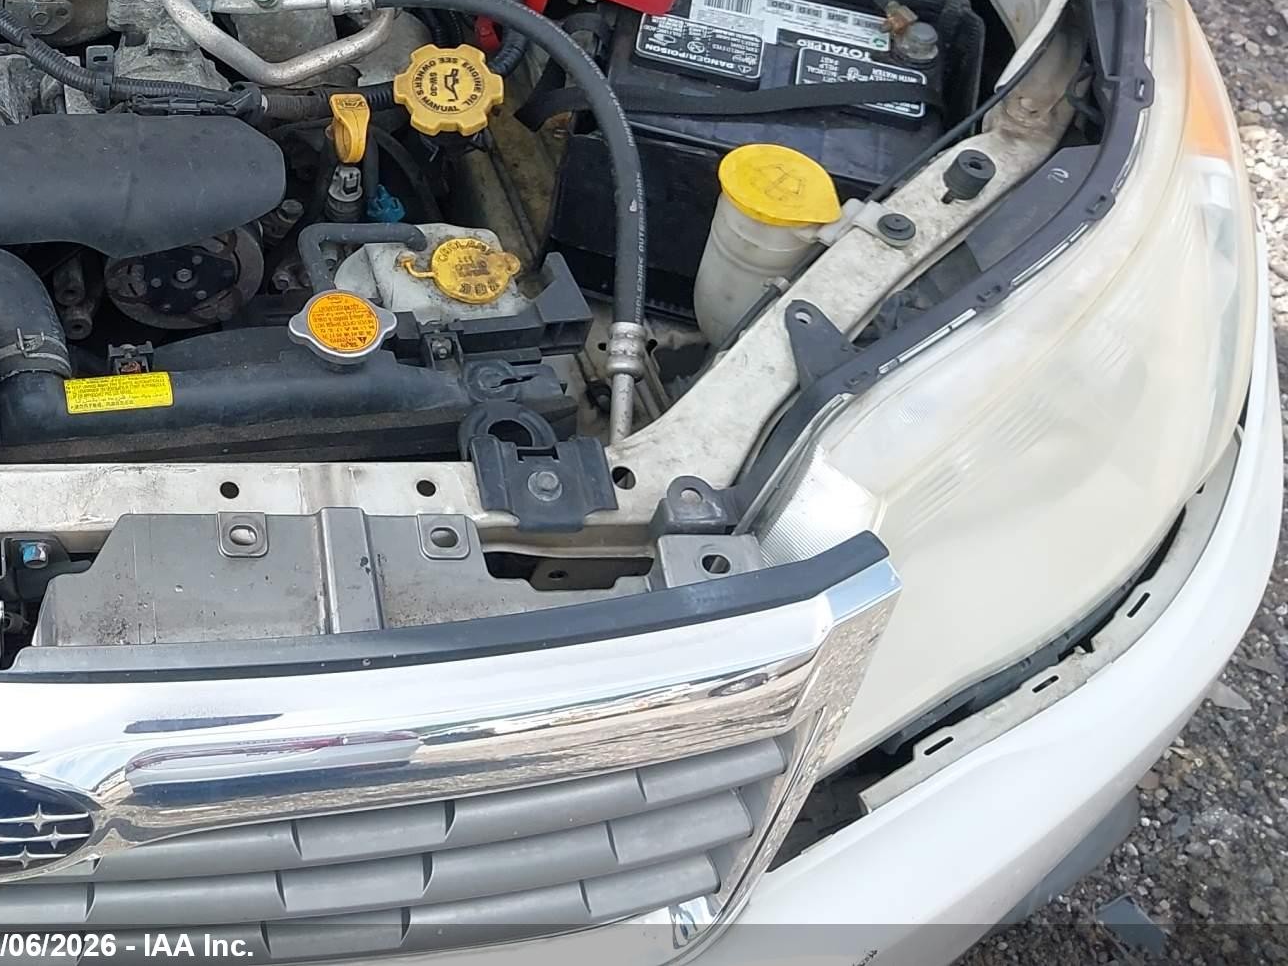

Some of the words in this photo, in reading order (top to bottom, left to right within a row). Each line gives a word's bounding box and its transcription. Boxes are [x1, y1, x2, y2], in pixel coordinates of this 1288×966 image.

[644, 43, 736, 69] DANGER/POISON
[461, 61, 482, 93] ENGINE
[420, 96, 460, 112] MANUAL
[462, 93, 479, 106] OIL
